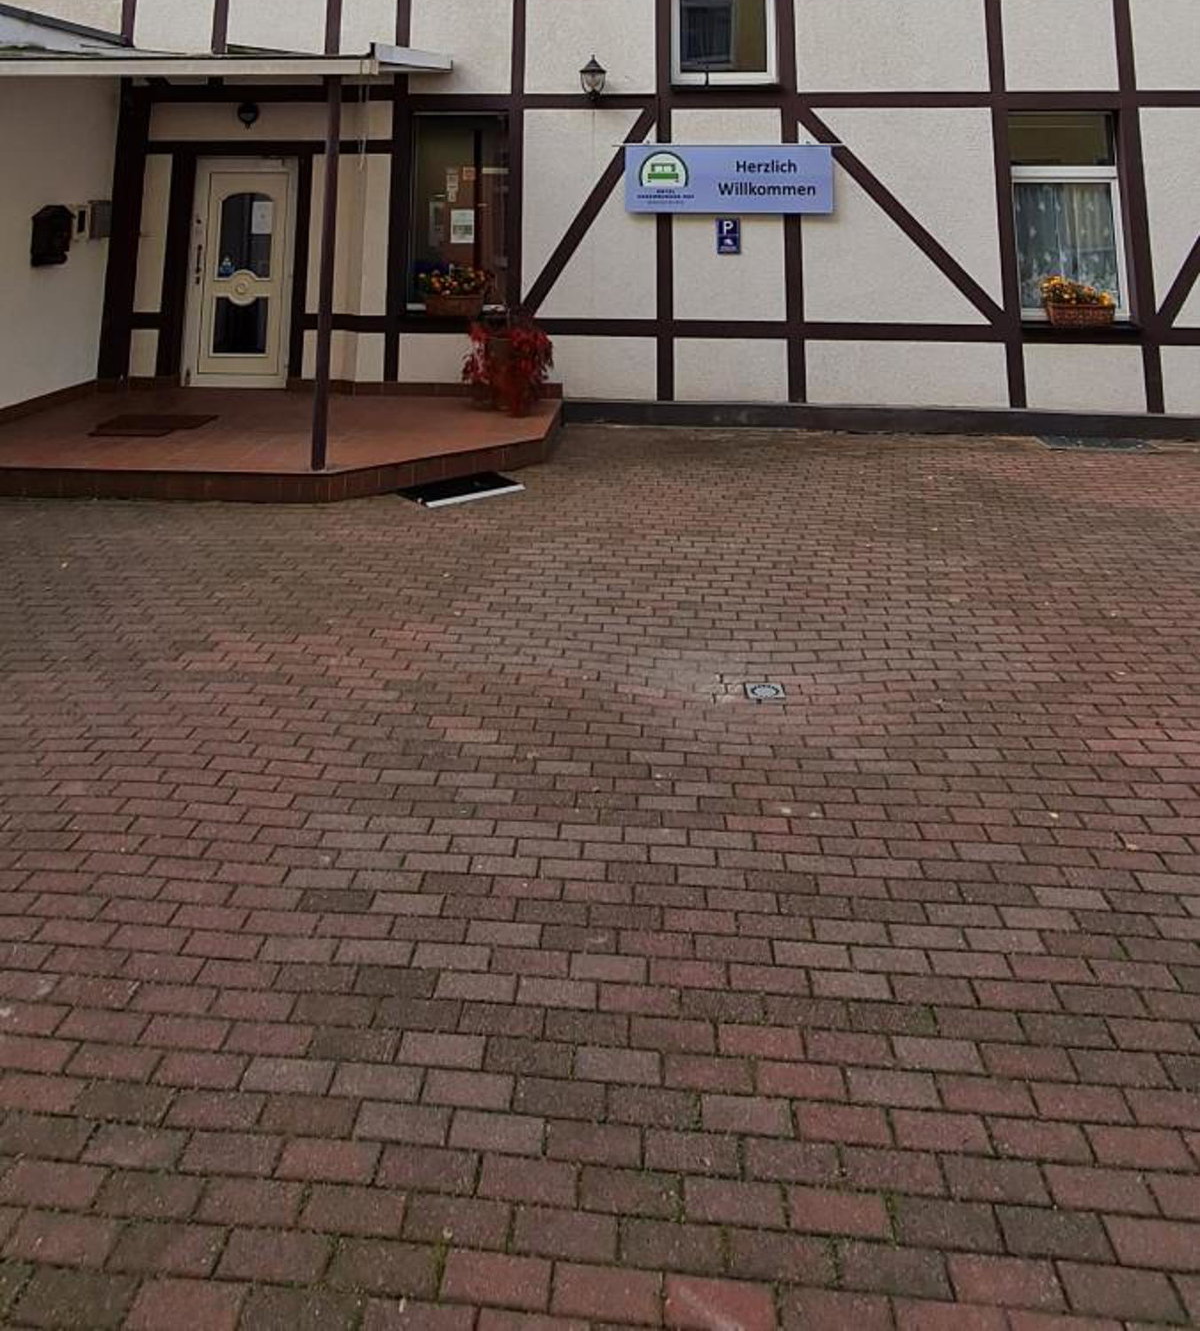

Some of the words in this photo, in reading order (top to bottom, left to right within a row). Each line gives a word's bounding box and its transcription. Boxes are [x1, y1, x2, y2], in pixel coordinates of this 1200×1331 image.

[736, 159, 797, 173] Herzlich
[718, 182, 816, 196] Willkommen
[723, 221, 734, 236] P
